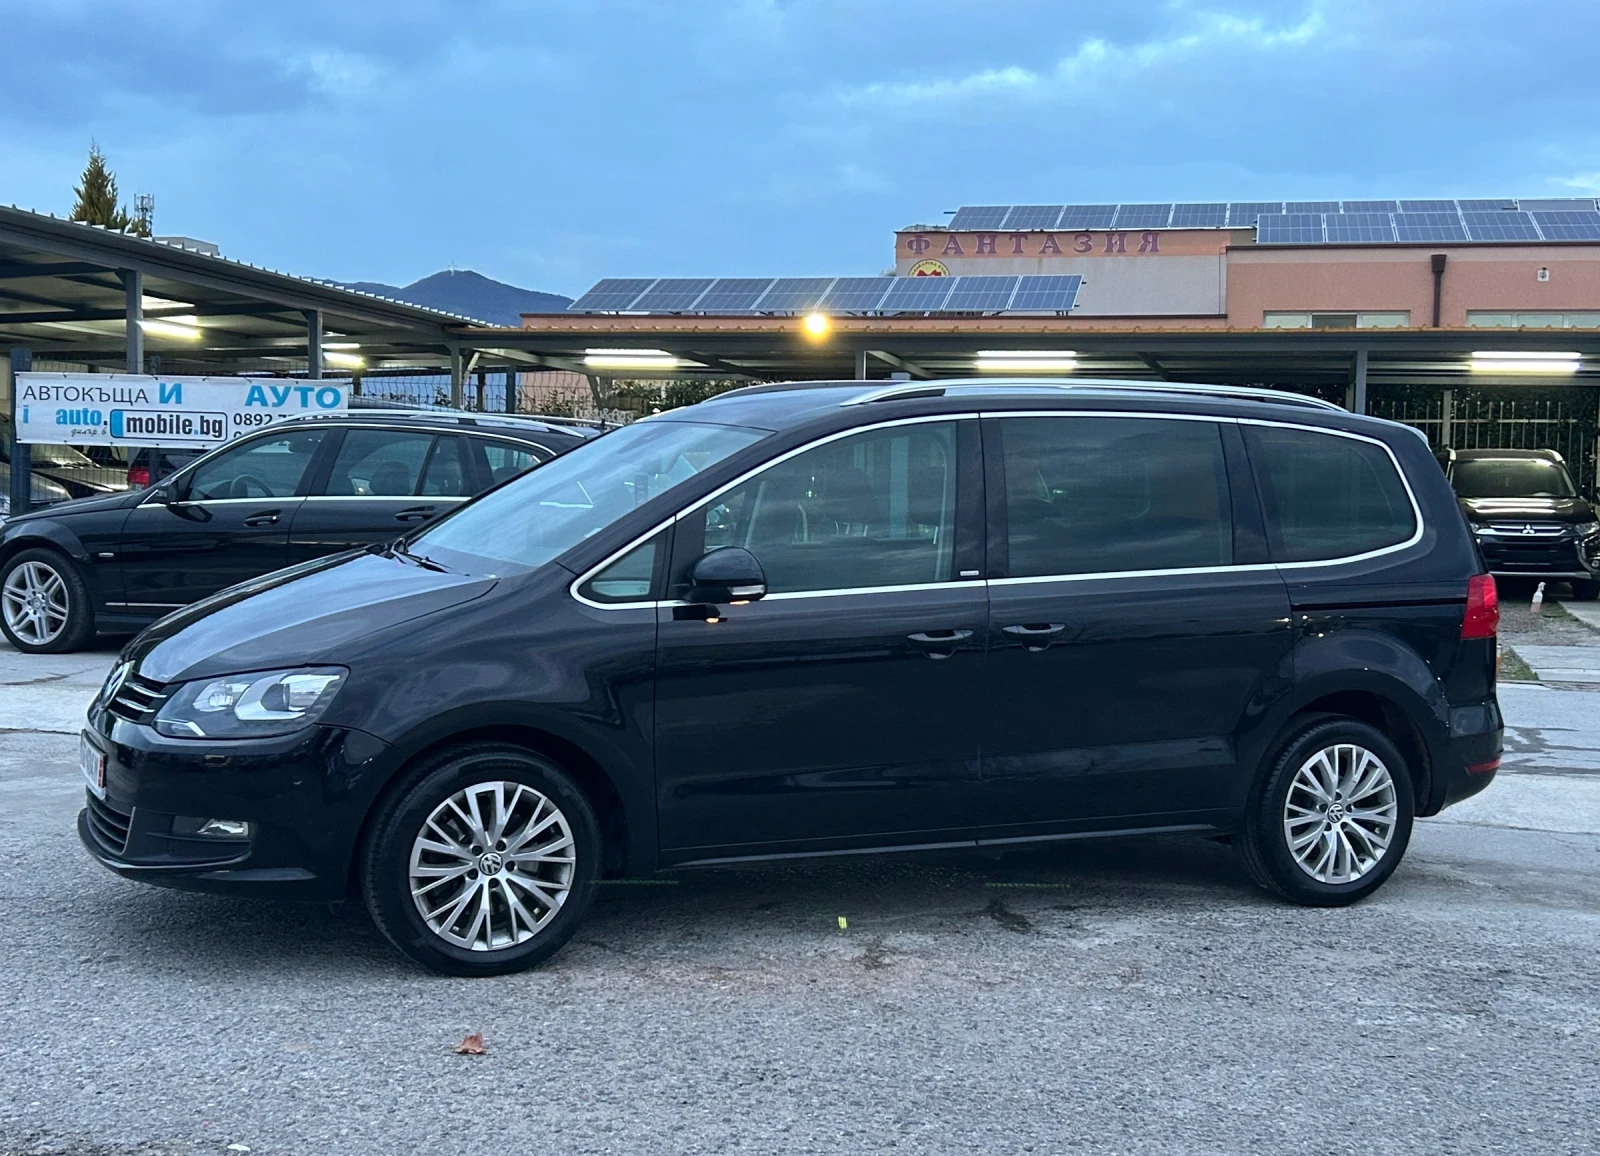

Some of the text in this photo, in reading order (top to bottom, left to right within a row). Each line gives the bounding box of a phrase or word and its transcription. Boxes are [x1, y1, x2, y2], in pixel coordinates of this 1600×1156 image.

[905, 231, 1161, 256] ФАНТАЗИЯ
[22, 382, 342, 409] АВТОКЪЩА И АУТО
[126, 413, 223, 438] mobile.bg
